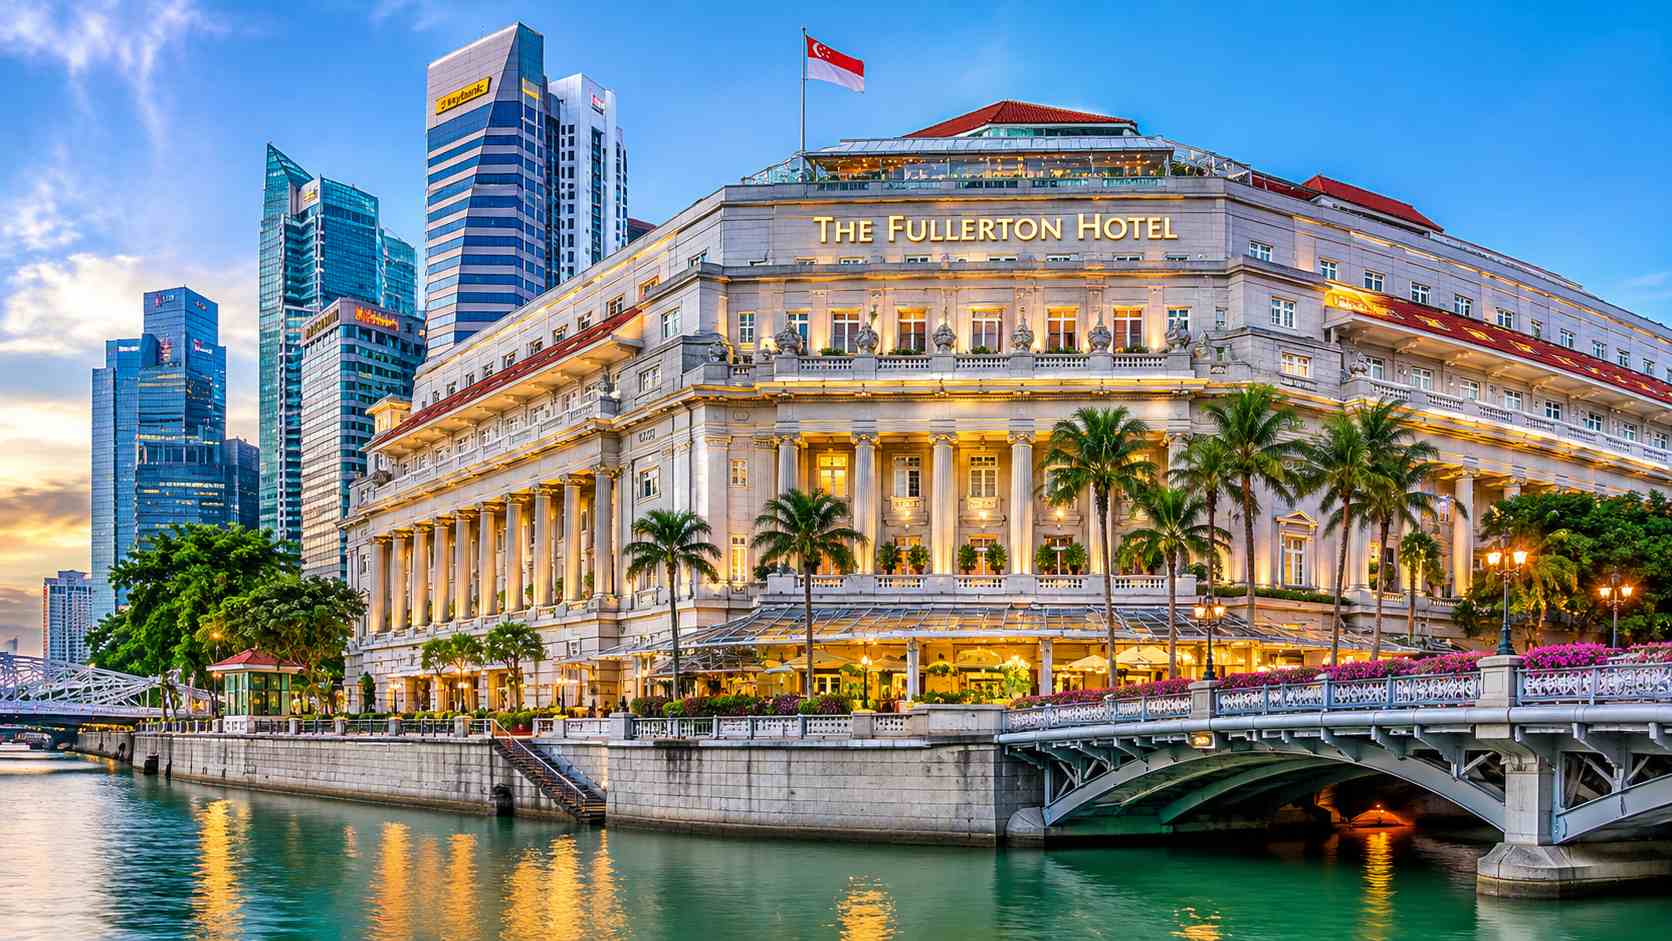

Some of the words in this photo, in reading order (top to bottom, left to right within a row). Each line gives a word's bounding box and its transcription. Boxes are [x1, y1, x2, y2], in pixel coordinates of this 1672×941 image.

[813, 216, 874, 243] THE
[887, 215, 1063, 242] FULLERTON
[1077, 213, 1179, 241] HOTEL
